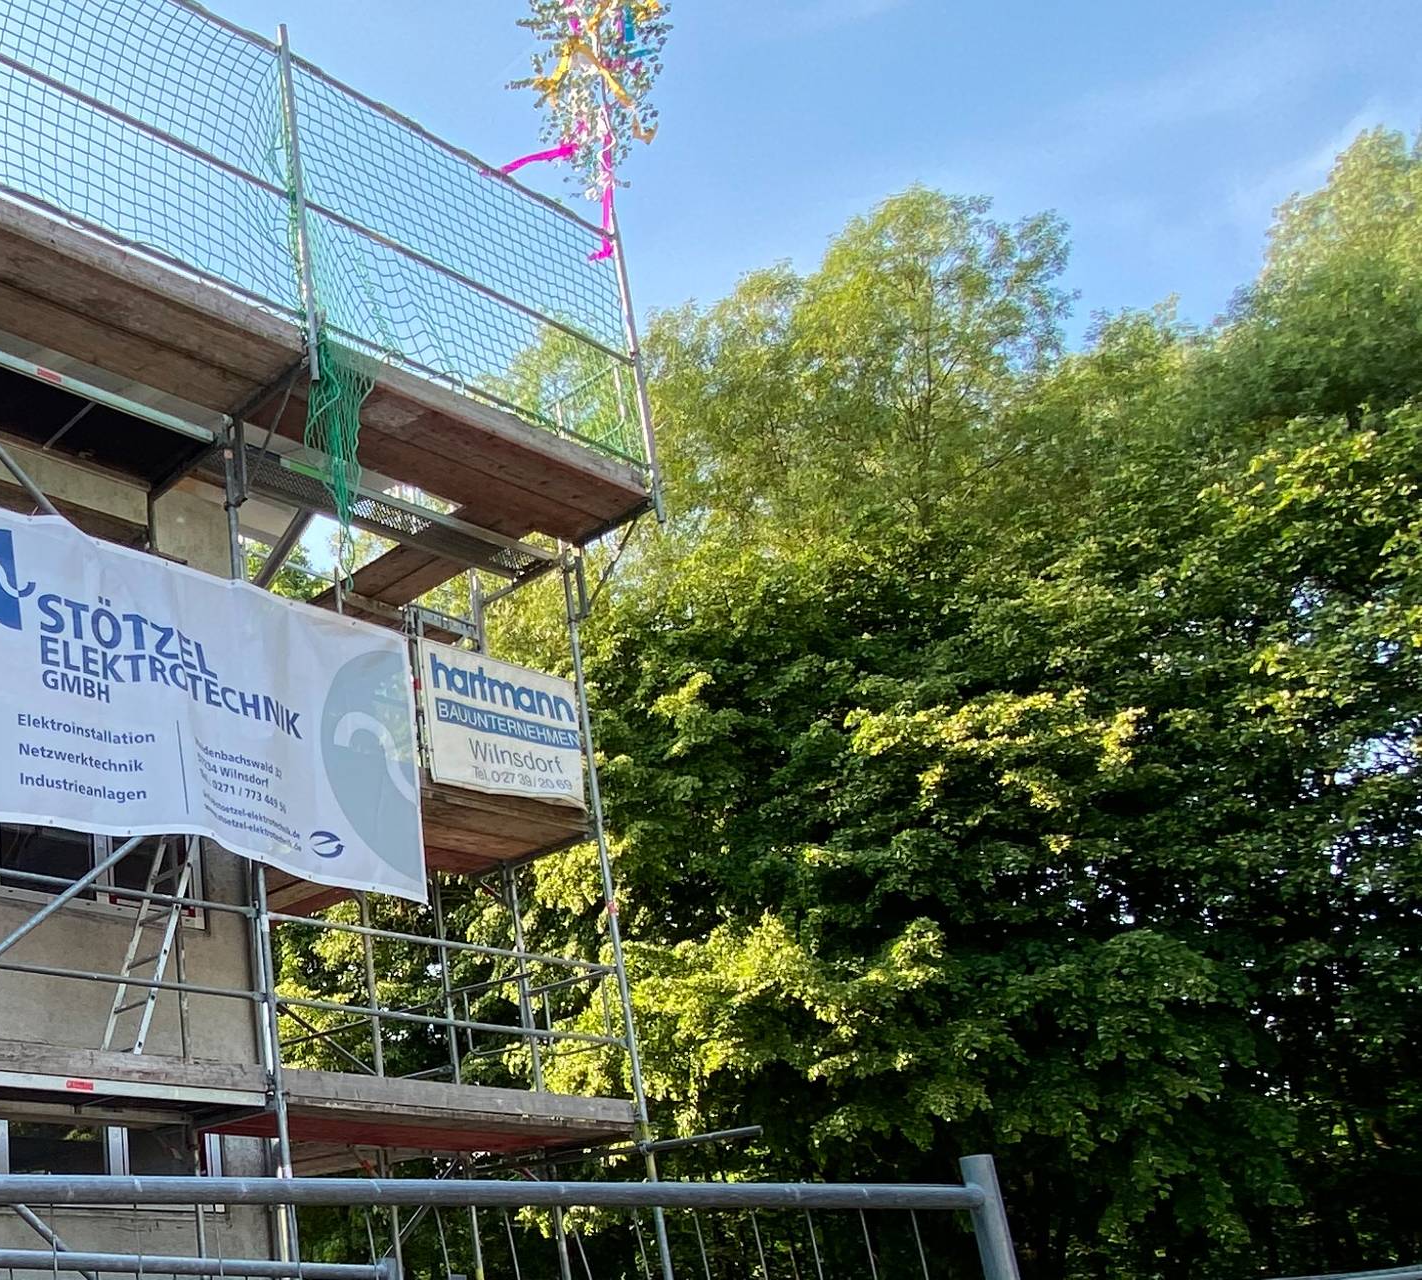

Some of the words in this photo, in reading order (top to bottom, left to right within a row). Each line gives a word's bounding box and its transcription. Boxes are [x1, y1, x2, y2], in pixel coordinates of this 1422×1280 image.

[37, 594, 218, 680] STÖTZEL
[40, 635, 303, 739] ELEKTROTECHNIK
[41, 669, 111, 703] GMBH
[429, 653, 576, 722] hartmann
[17, 713, 156, 745] Elektroinstallation
[438, 702, 579, 746] BAUUNTERNEHMEN
[18, 743, 144, 772] Netzwerktechnik
[468, 737, 563, 774] Wilnsdorf
[19, 772, 147, 803] Industrieanlagen
[219, 766, 268, 788] Wilnsdorf
[244, 788, 262, 801] 773
